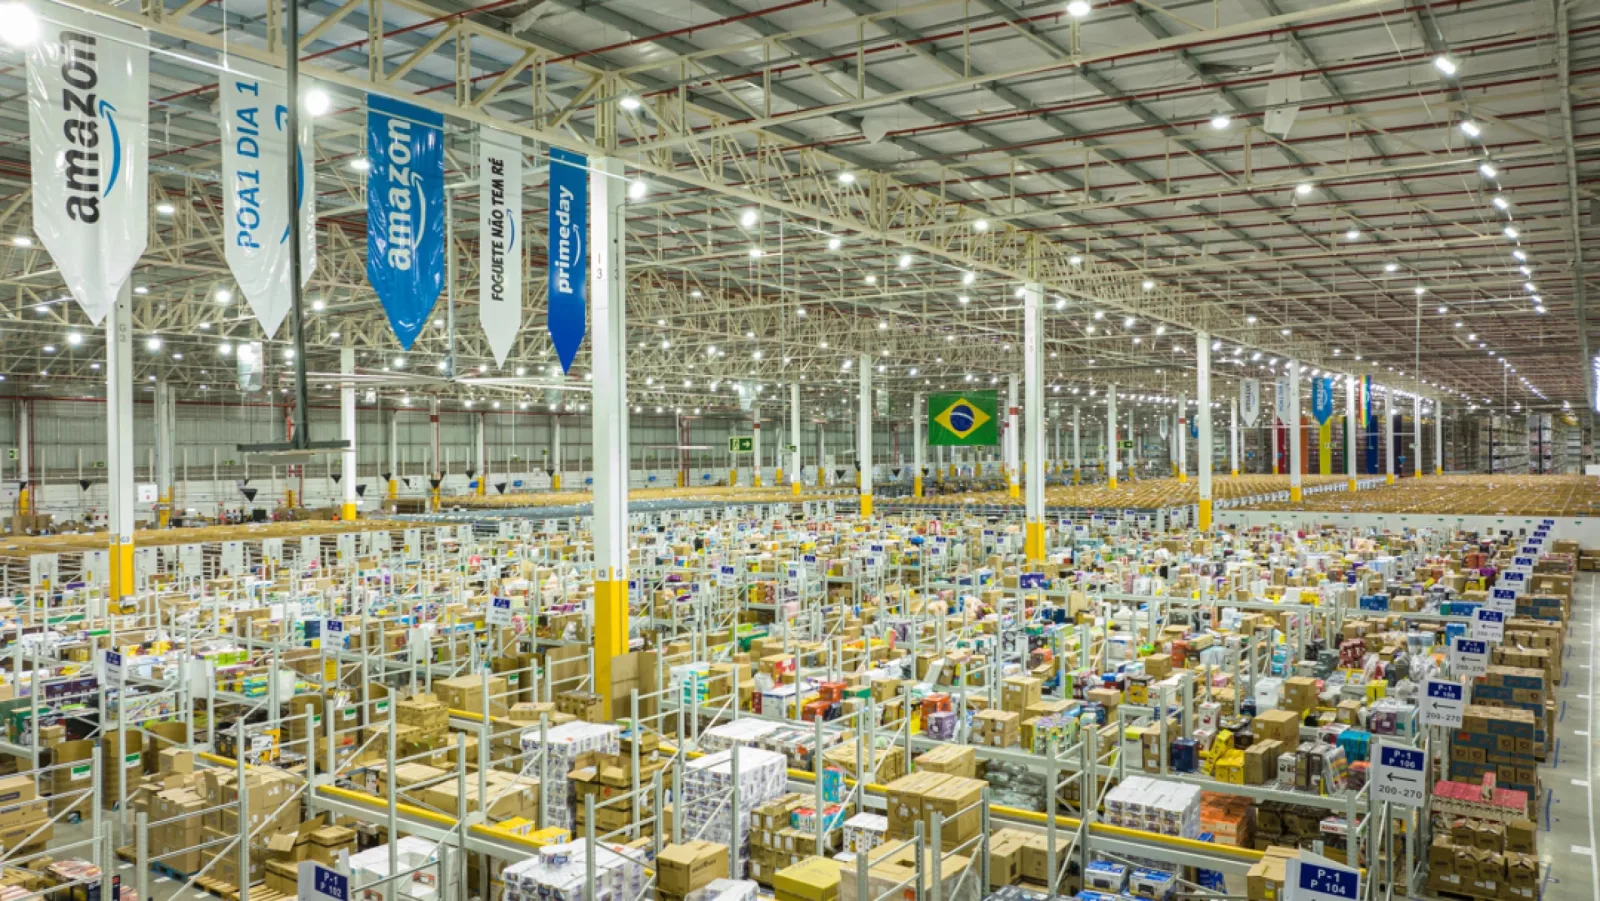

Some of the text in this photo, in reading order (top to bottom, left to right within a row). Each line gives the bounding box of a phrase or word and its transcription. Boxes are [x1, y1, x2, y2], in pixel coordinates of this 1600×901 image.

[59, 30, 100, 224] amazon
[235, 80, 260, 248] POA1 DIA 1
[387, 118, 411, 271] amazon
[487, 157, 505, 301] FOGUETE NÃO TEM RÉ
[554, 184, 574, 294] primeday
[1437, 684, 1453, 692] P-1
[1425, 711, 1462, 722] 200-270
[1393, 749, 1411, 760] P-1
[1389, 757, 1416, 769] P 106
[1378, 784, 1423, 799] 200-270
[323, 870, 338, 886] P-1
[1317, 869, 1340, 883] P-1
[320, 881, 342, 898] P 102
[1310, 879, 1346, 895] P 104
